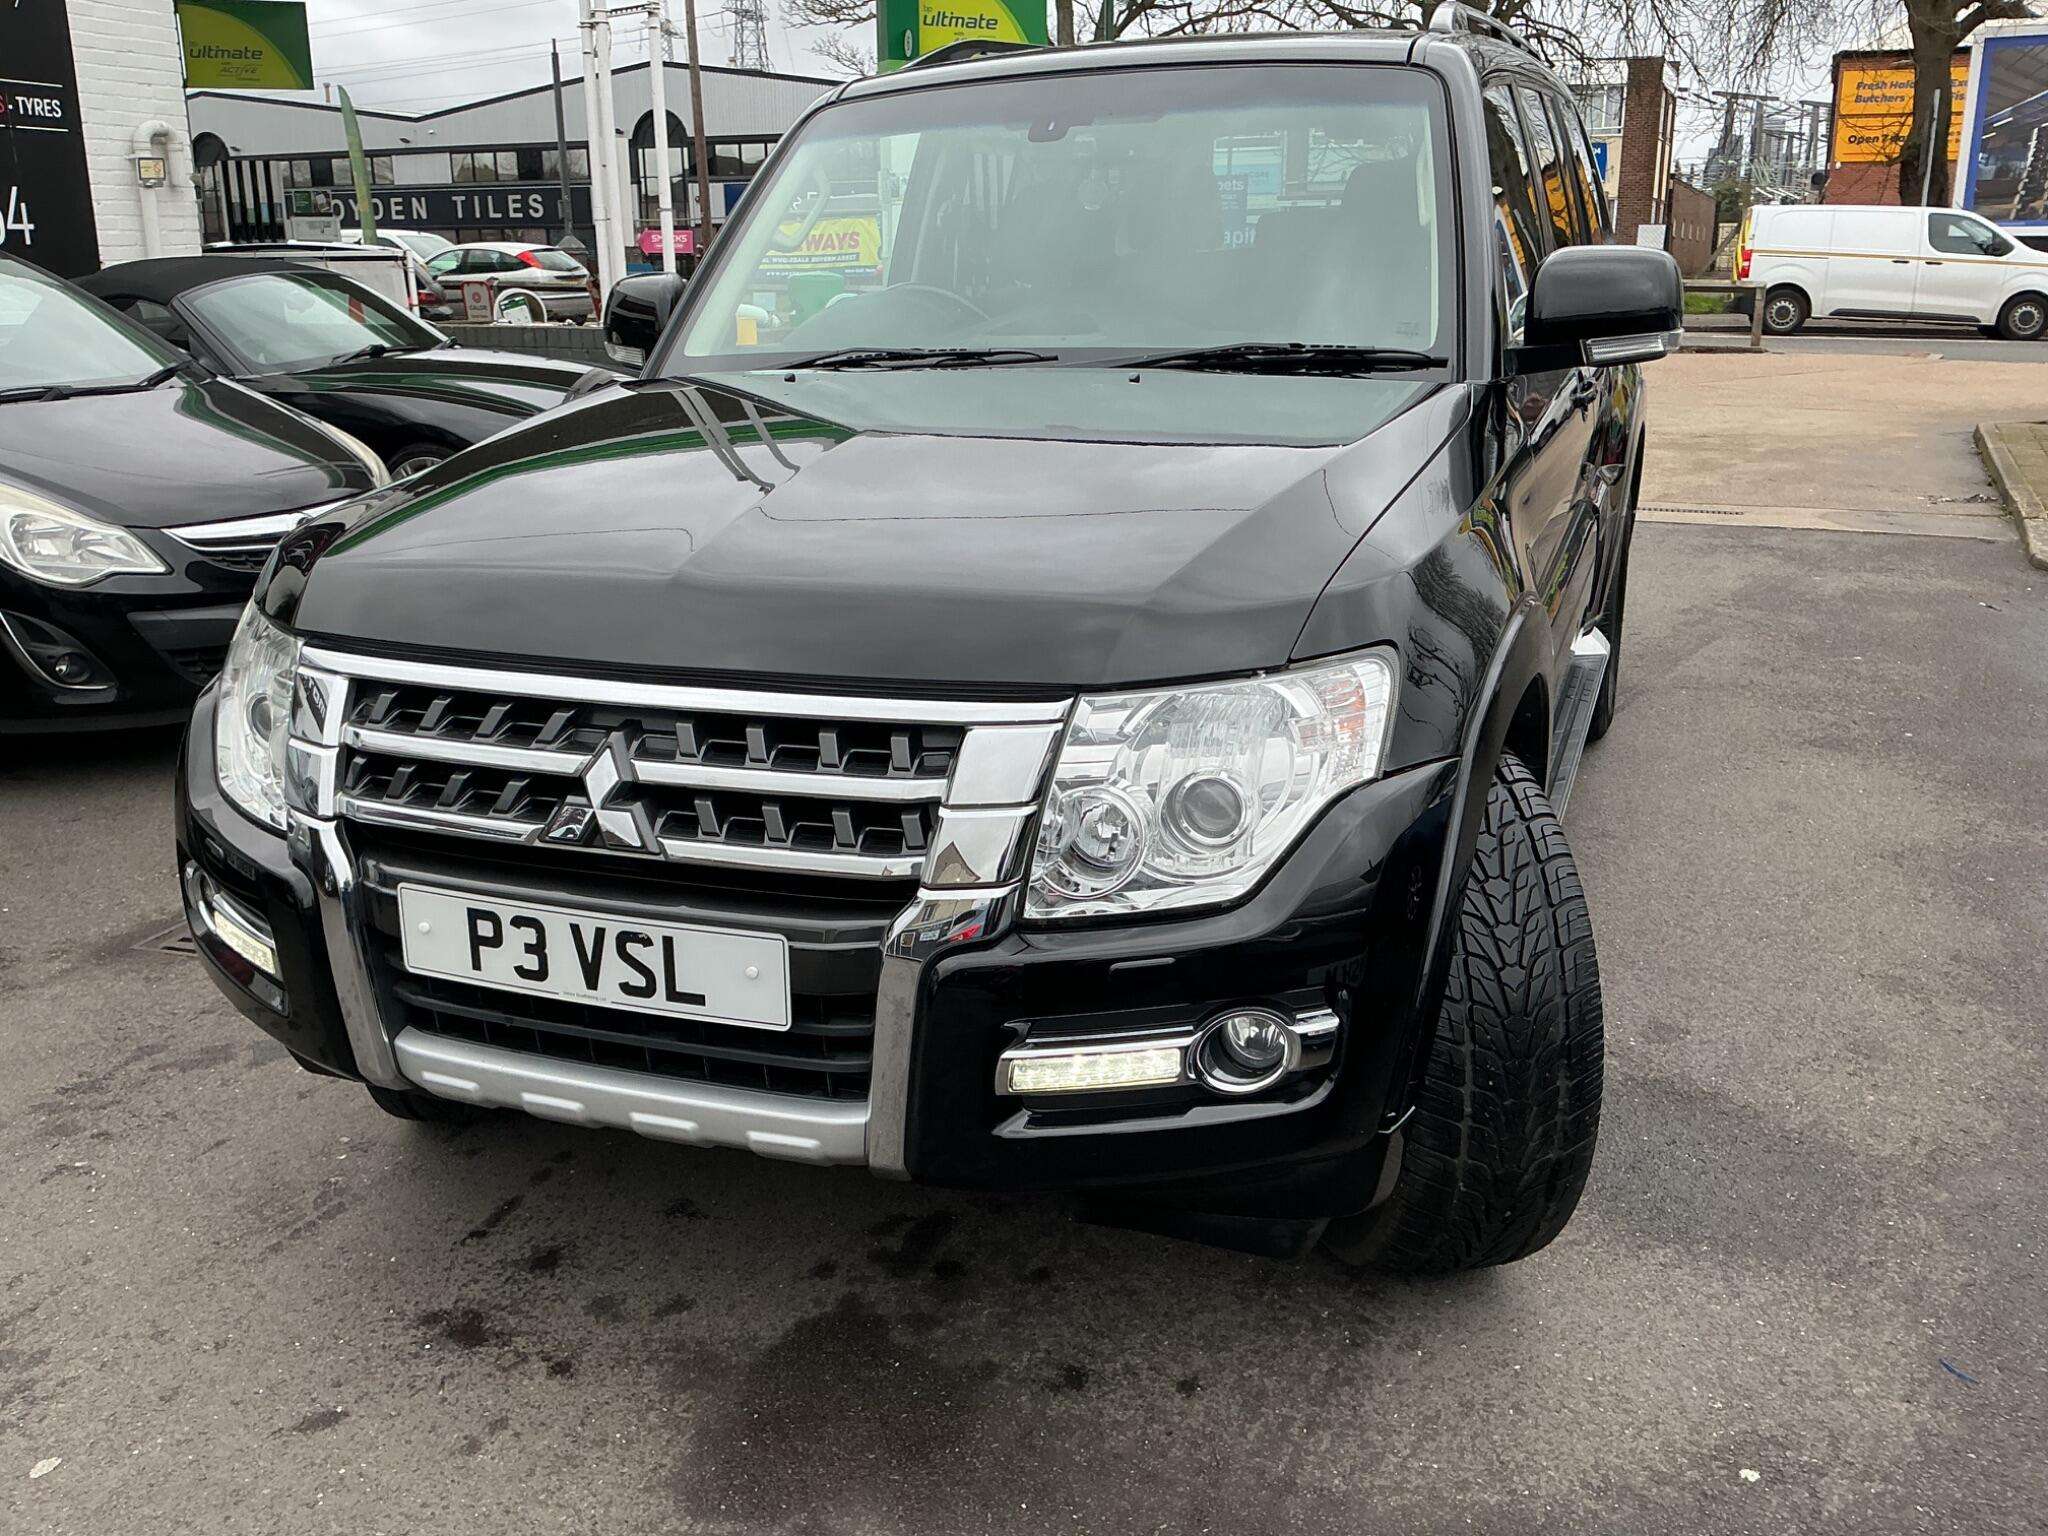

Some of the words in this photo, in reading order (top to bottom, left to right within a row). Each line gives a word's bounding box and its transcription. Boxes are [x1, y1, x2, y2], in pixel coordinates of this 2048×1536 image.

[922, 11, 998, 30] ultimate
[189, 45, 263, 60] ultimate
[1856, 80, 1888, 90] Fresh
[14, 96, 62, 118] TYRES
[1854, 94, 1906, 104] Butchers
[1847, 134, 1880, 146] Open
[331, 197, 428, 221] OYDEN
[451, 193, 545, 219] TILES
[466, 907, 549, 982] P3
[569, 922, 706, 1007] VSL
